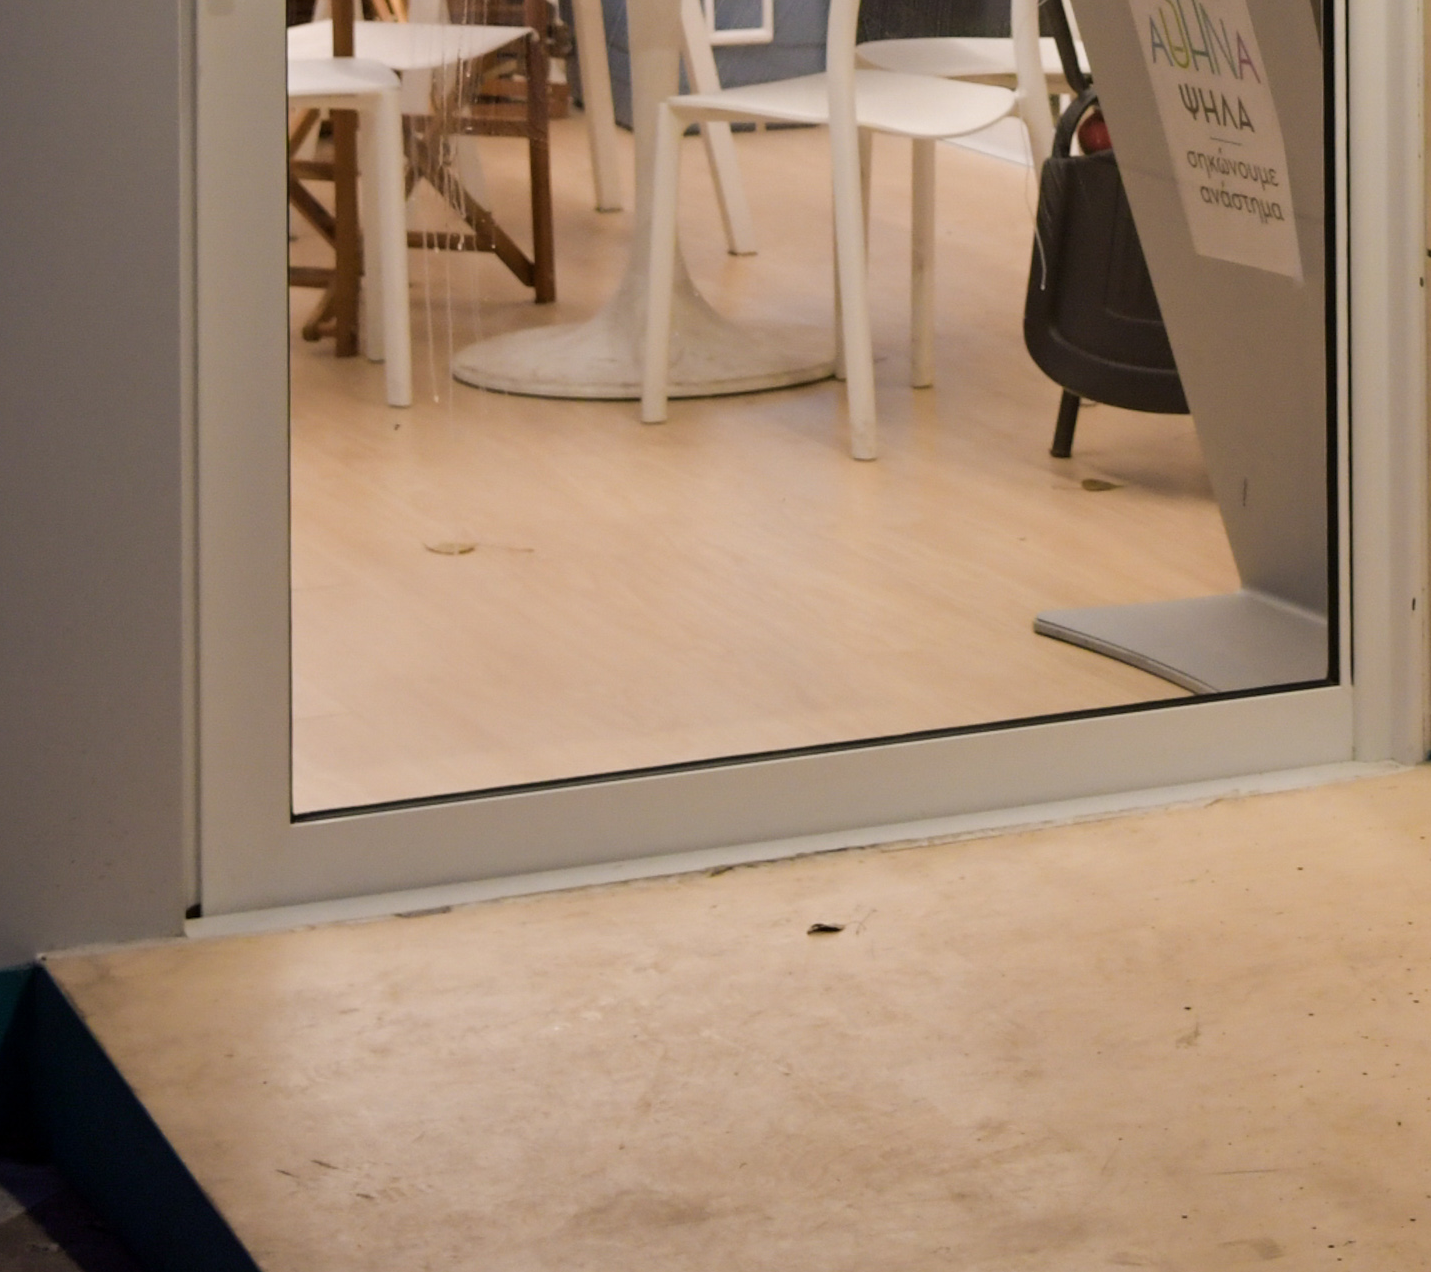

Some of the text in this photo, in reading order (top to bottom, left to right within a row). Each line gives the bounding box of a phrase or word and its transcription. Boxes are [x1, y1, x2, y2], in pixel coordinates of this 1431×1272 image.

[1179, 83, 1256, 134] ΨΗΛΑ
[1186, 147, 1280, 189] σηκώνουμε
[1200, 182, 1285, 226] ανάστημα
